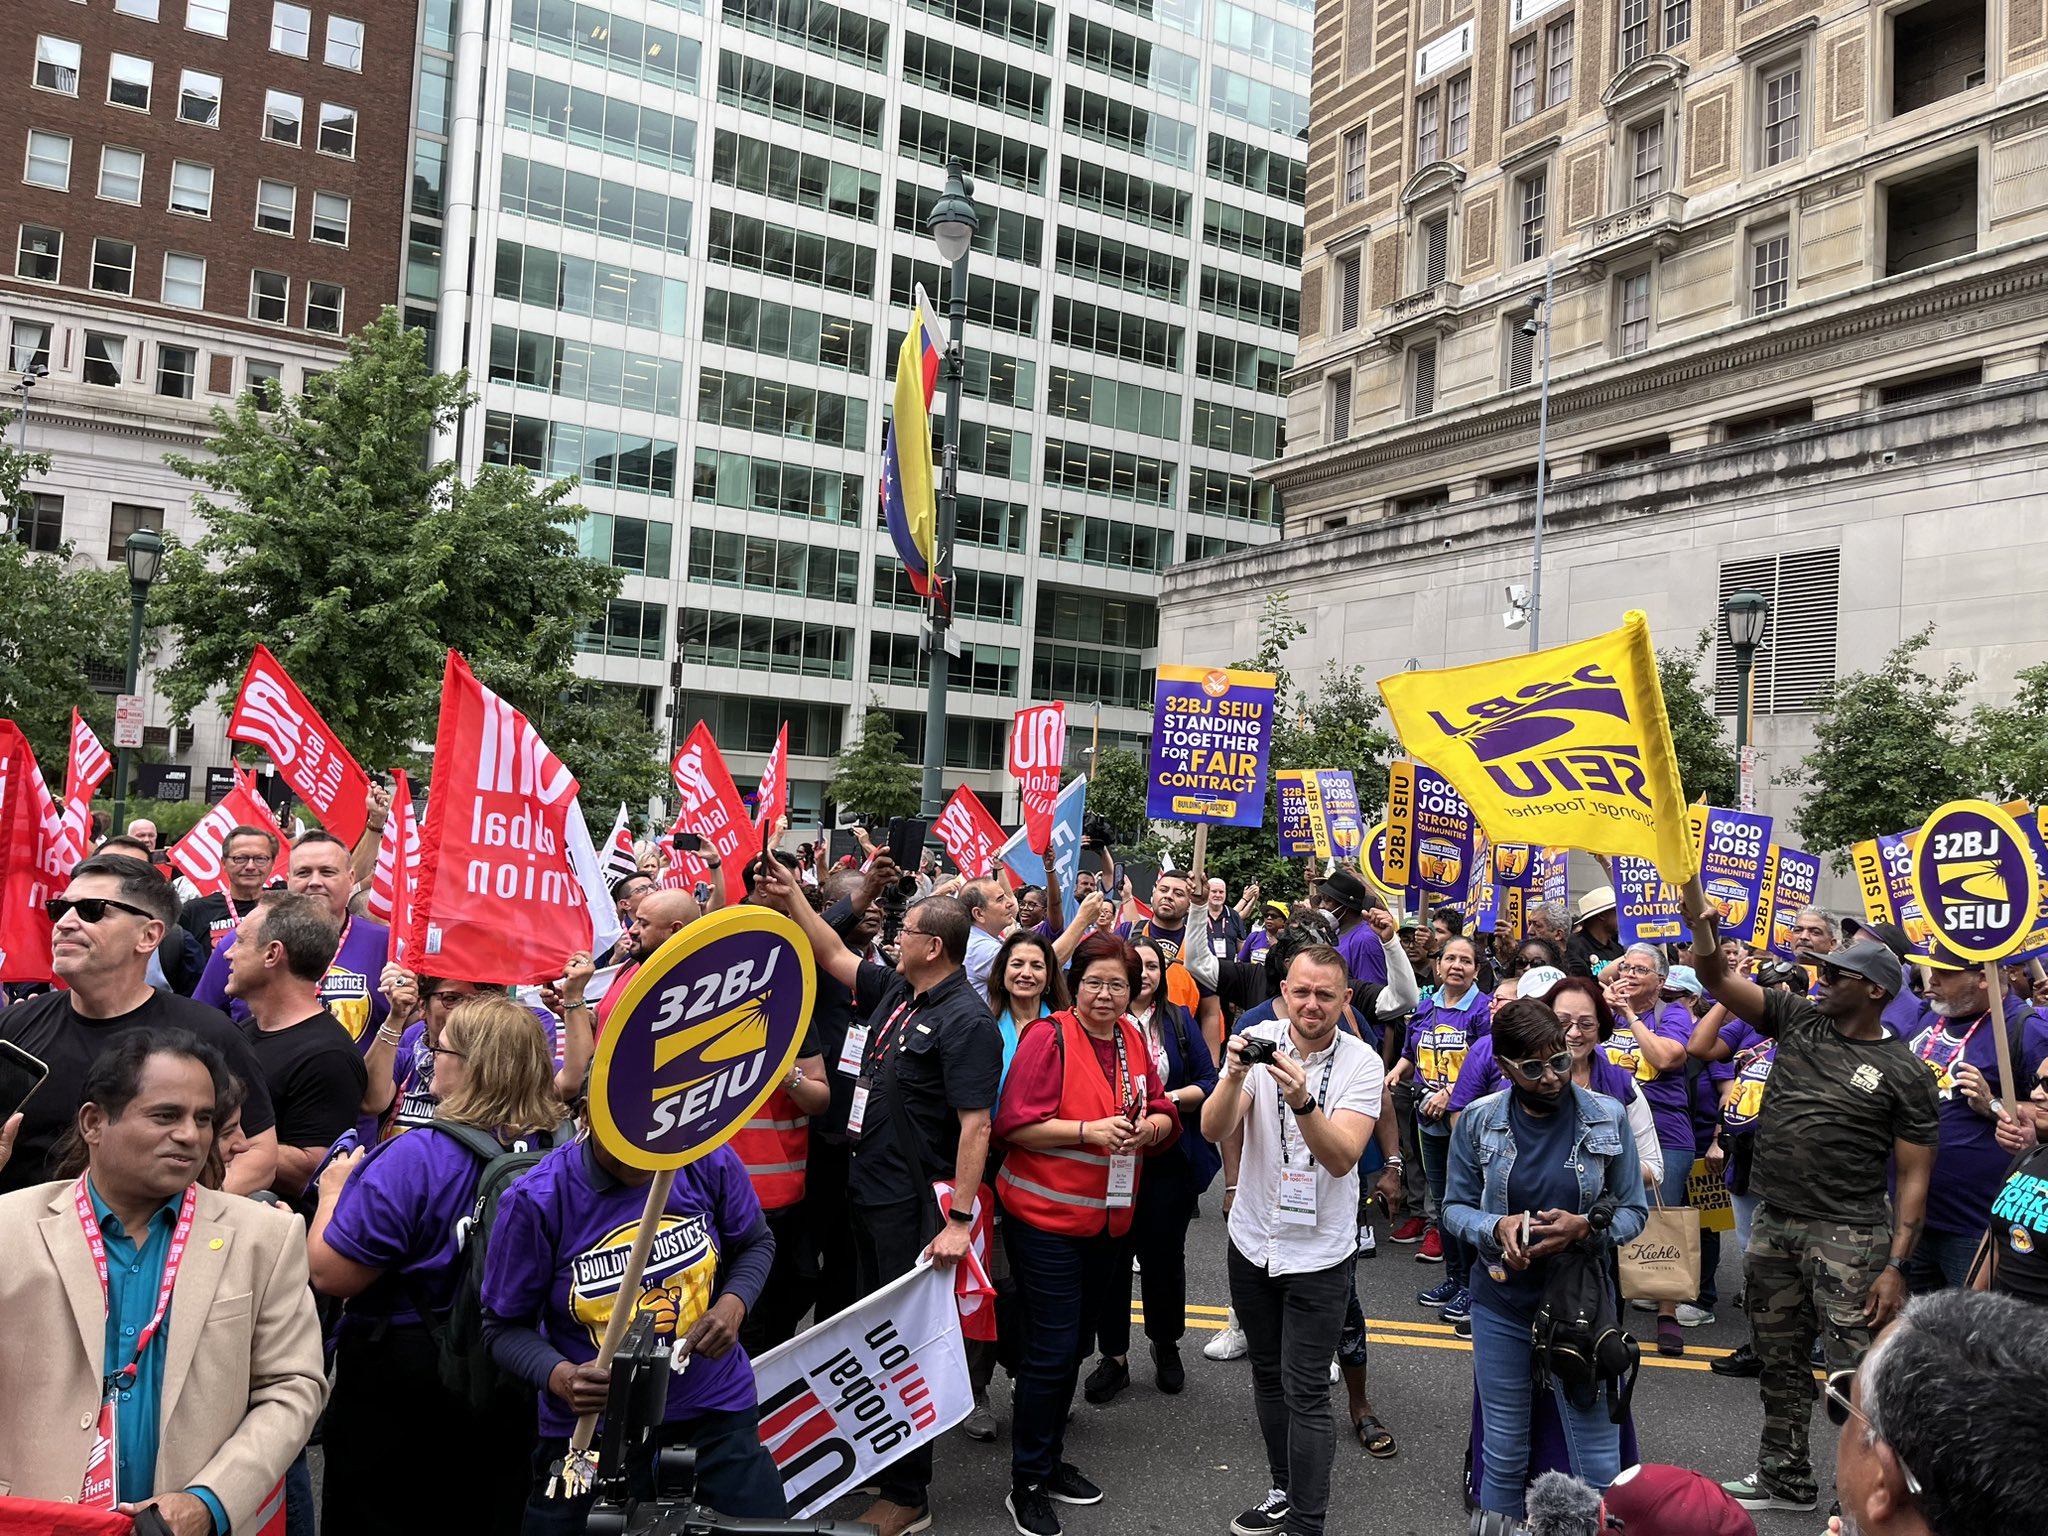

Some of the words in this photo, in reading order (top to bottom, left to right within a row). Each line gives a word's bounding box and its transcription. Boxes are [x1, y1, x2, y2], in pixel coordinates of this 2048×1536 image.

[1165, 696, 1212, 714] 32BJ
[1218, 700, 1262, 719] SEIU
[1164, 714, 1261, 736] STANDING
[1163, 730, 1259, 752] TOGETHER
[1161, 747, 1189, 760] FOR
[1191, 750, 1258, 777] FAIR
[1178, 761, 1188, 772] A
[1159, 772, 1257, 793] CONTRACT
[1321, 779, 1349, 788] GOOD
[1418, 778, 1462, 799] GOO
[1307, 781, 1319, 810] SEIU
[1324, 789, 1353, 800] JOBS
[1326, 801, 1355, 809] STRONG
[1393, 776, 1409, 818] SEIU
[1418, 794, 1469, 818] JOBS
[1313, 816, 1326, 847] 32BJ
[1417, 823, 1467, 840] COMMUNITIES
[1418, 811, 1468, 831] STRONG
[1711, 820, 1763, 840] GOOD
[1388, 825, 1407, 870] 32BJ
[1709, 835, 1761, 858] JOBS
[1933, 829, 1999, 860] 32BJ
[1705, 865, 1756, 880] COMMUNITIES
[1707, 854, 1758, 871] STRONG
[1780, 857, 1814, 877] GOOD
[1778, 870, 1813, 893] JOBS
[1859, 855, 1881, 896] SEIU
[1622, 884, 1642, 894] FOR
[1636, 895, 1644, 904] A
[1708, 883, 1728, 894] BUILDING
[1729, 887, 1747, 897] JUSTICE
[1755, 898, 1769, 936] 32BJ
[1762, 855, 1774, 891] SEIU
[1777, 886, 1810, 904] STRONG
[1510, 893, 1519, 928] 32BJ
[1944, 903, 2010, 931] SEIU
[324, 976, 363, 990] JUSTICE
[651, 945, 781, 1032] 32BJ
[646, 1050, 766, 1142] SEIU
[400, 1098, 435, 1117] UILDIN
[2006, 1171, 2048, 1197] AIRP
[653, 1220, 701, 1262] JUSTICE
[1628, 1243, 1681, 1260] Kiehl's
[864, 1319, 937, 1431] union
[809, 1347, 912, 1455] global
